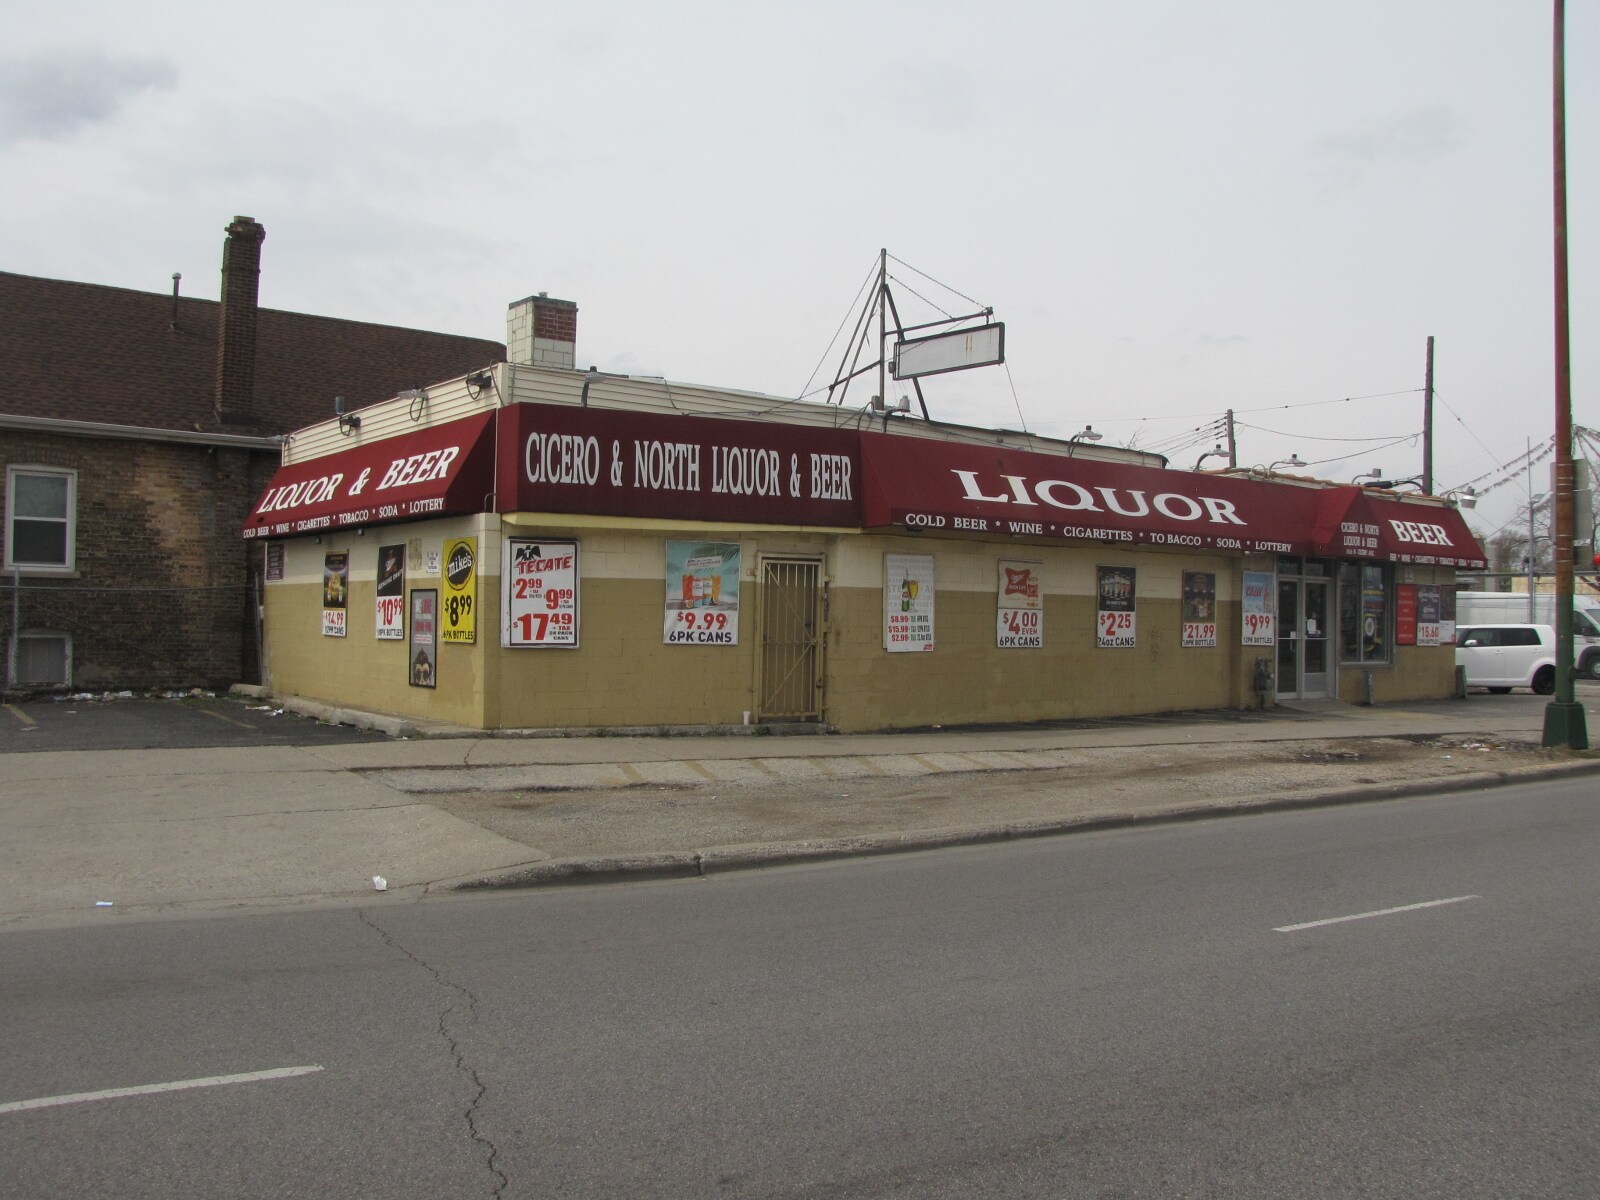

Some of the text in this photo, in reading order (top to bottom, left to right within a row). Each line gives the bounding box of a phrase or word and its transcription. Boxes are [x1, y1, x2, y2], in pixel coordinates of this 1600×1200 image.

[526, 432, 852, 500] CICERO & NORTH LIQUOR & BEER
[256, 446, 459, 514] LIQUOR & BEER
[950, 469, 1248, 526] LIQUOR
[243, 498, 444, 538] COLD BEER WINE CIGARETTES TOBACCO SODA LOTTERY
[905, 513, 946, 527] COLD
[954, 516, 988, 531] BEER
[1008, 521, 1043, 535] WINE
[1063, 526, 1133, 541] CIGARETTES
[1216, 537, 1241, 549] SODA
[1255, 541, 1292, 553] LOTTERY
[1388, 519, 1454, 547] BEER
[448, 552, 472, 577] mike's
[513, 555, 573, 575] TECATE
[677, 611, 728, 630] $9.99
[890, 615, 909, 624] $8.99
[453, 630, 473, 640] BOTTLES
[669, 631, 732, 643] 6PK CANS
[888, 625, 909, 634] $15.99
[891, 634, 908, 642] $2.99
[1184, 624, 1215, 639] $21.99
[999, 636, 1040, 647] 6PK CANS
[1115, 637, 1135, 647] CANS
[1253, 636, 1272, 644] BOTTLES
